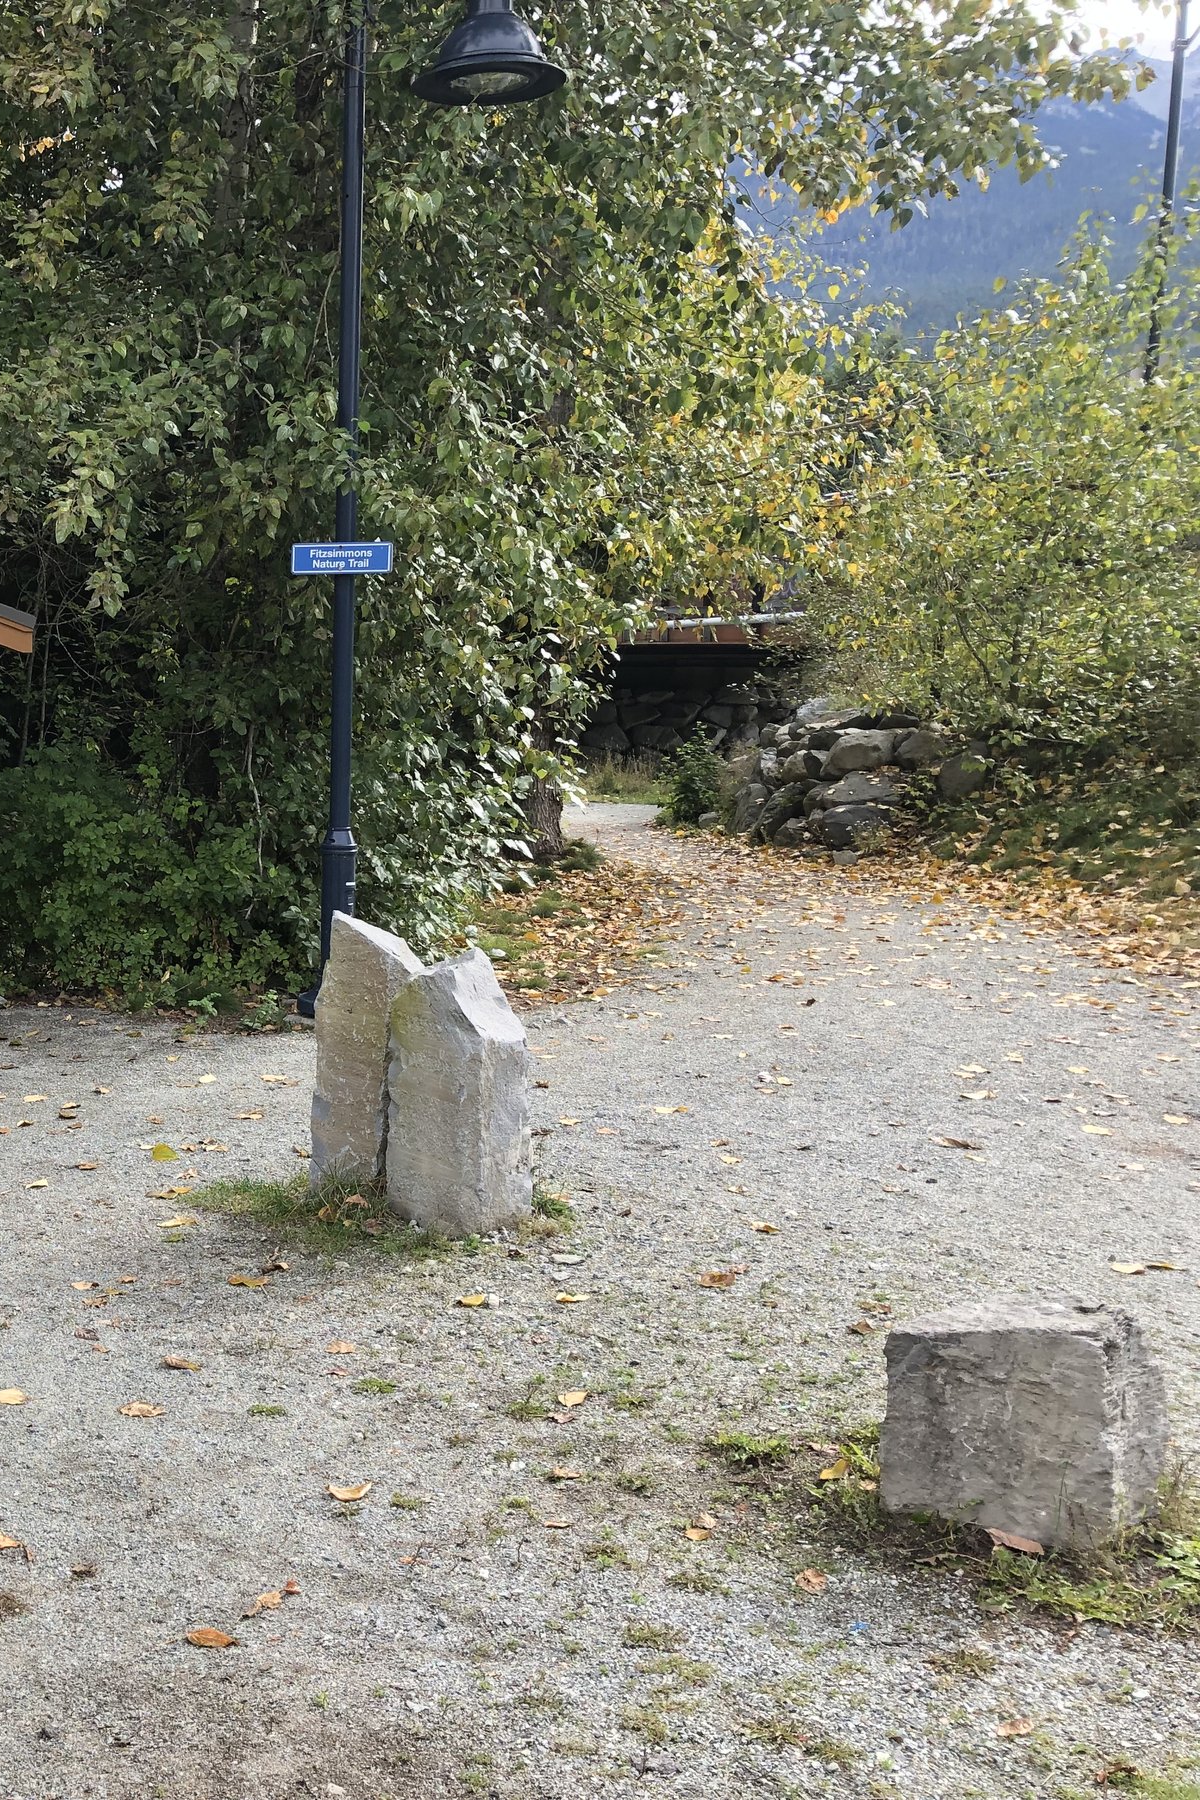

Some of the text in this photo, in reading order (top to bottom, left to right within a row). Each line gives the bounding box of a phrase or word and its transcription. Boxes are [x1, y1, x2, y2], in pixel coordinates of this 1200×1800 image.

[310, 549, 373, 558] Fitzsimmons
[312, 558, 369, 568] Nature Trail
